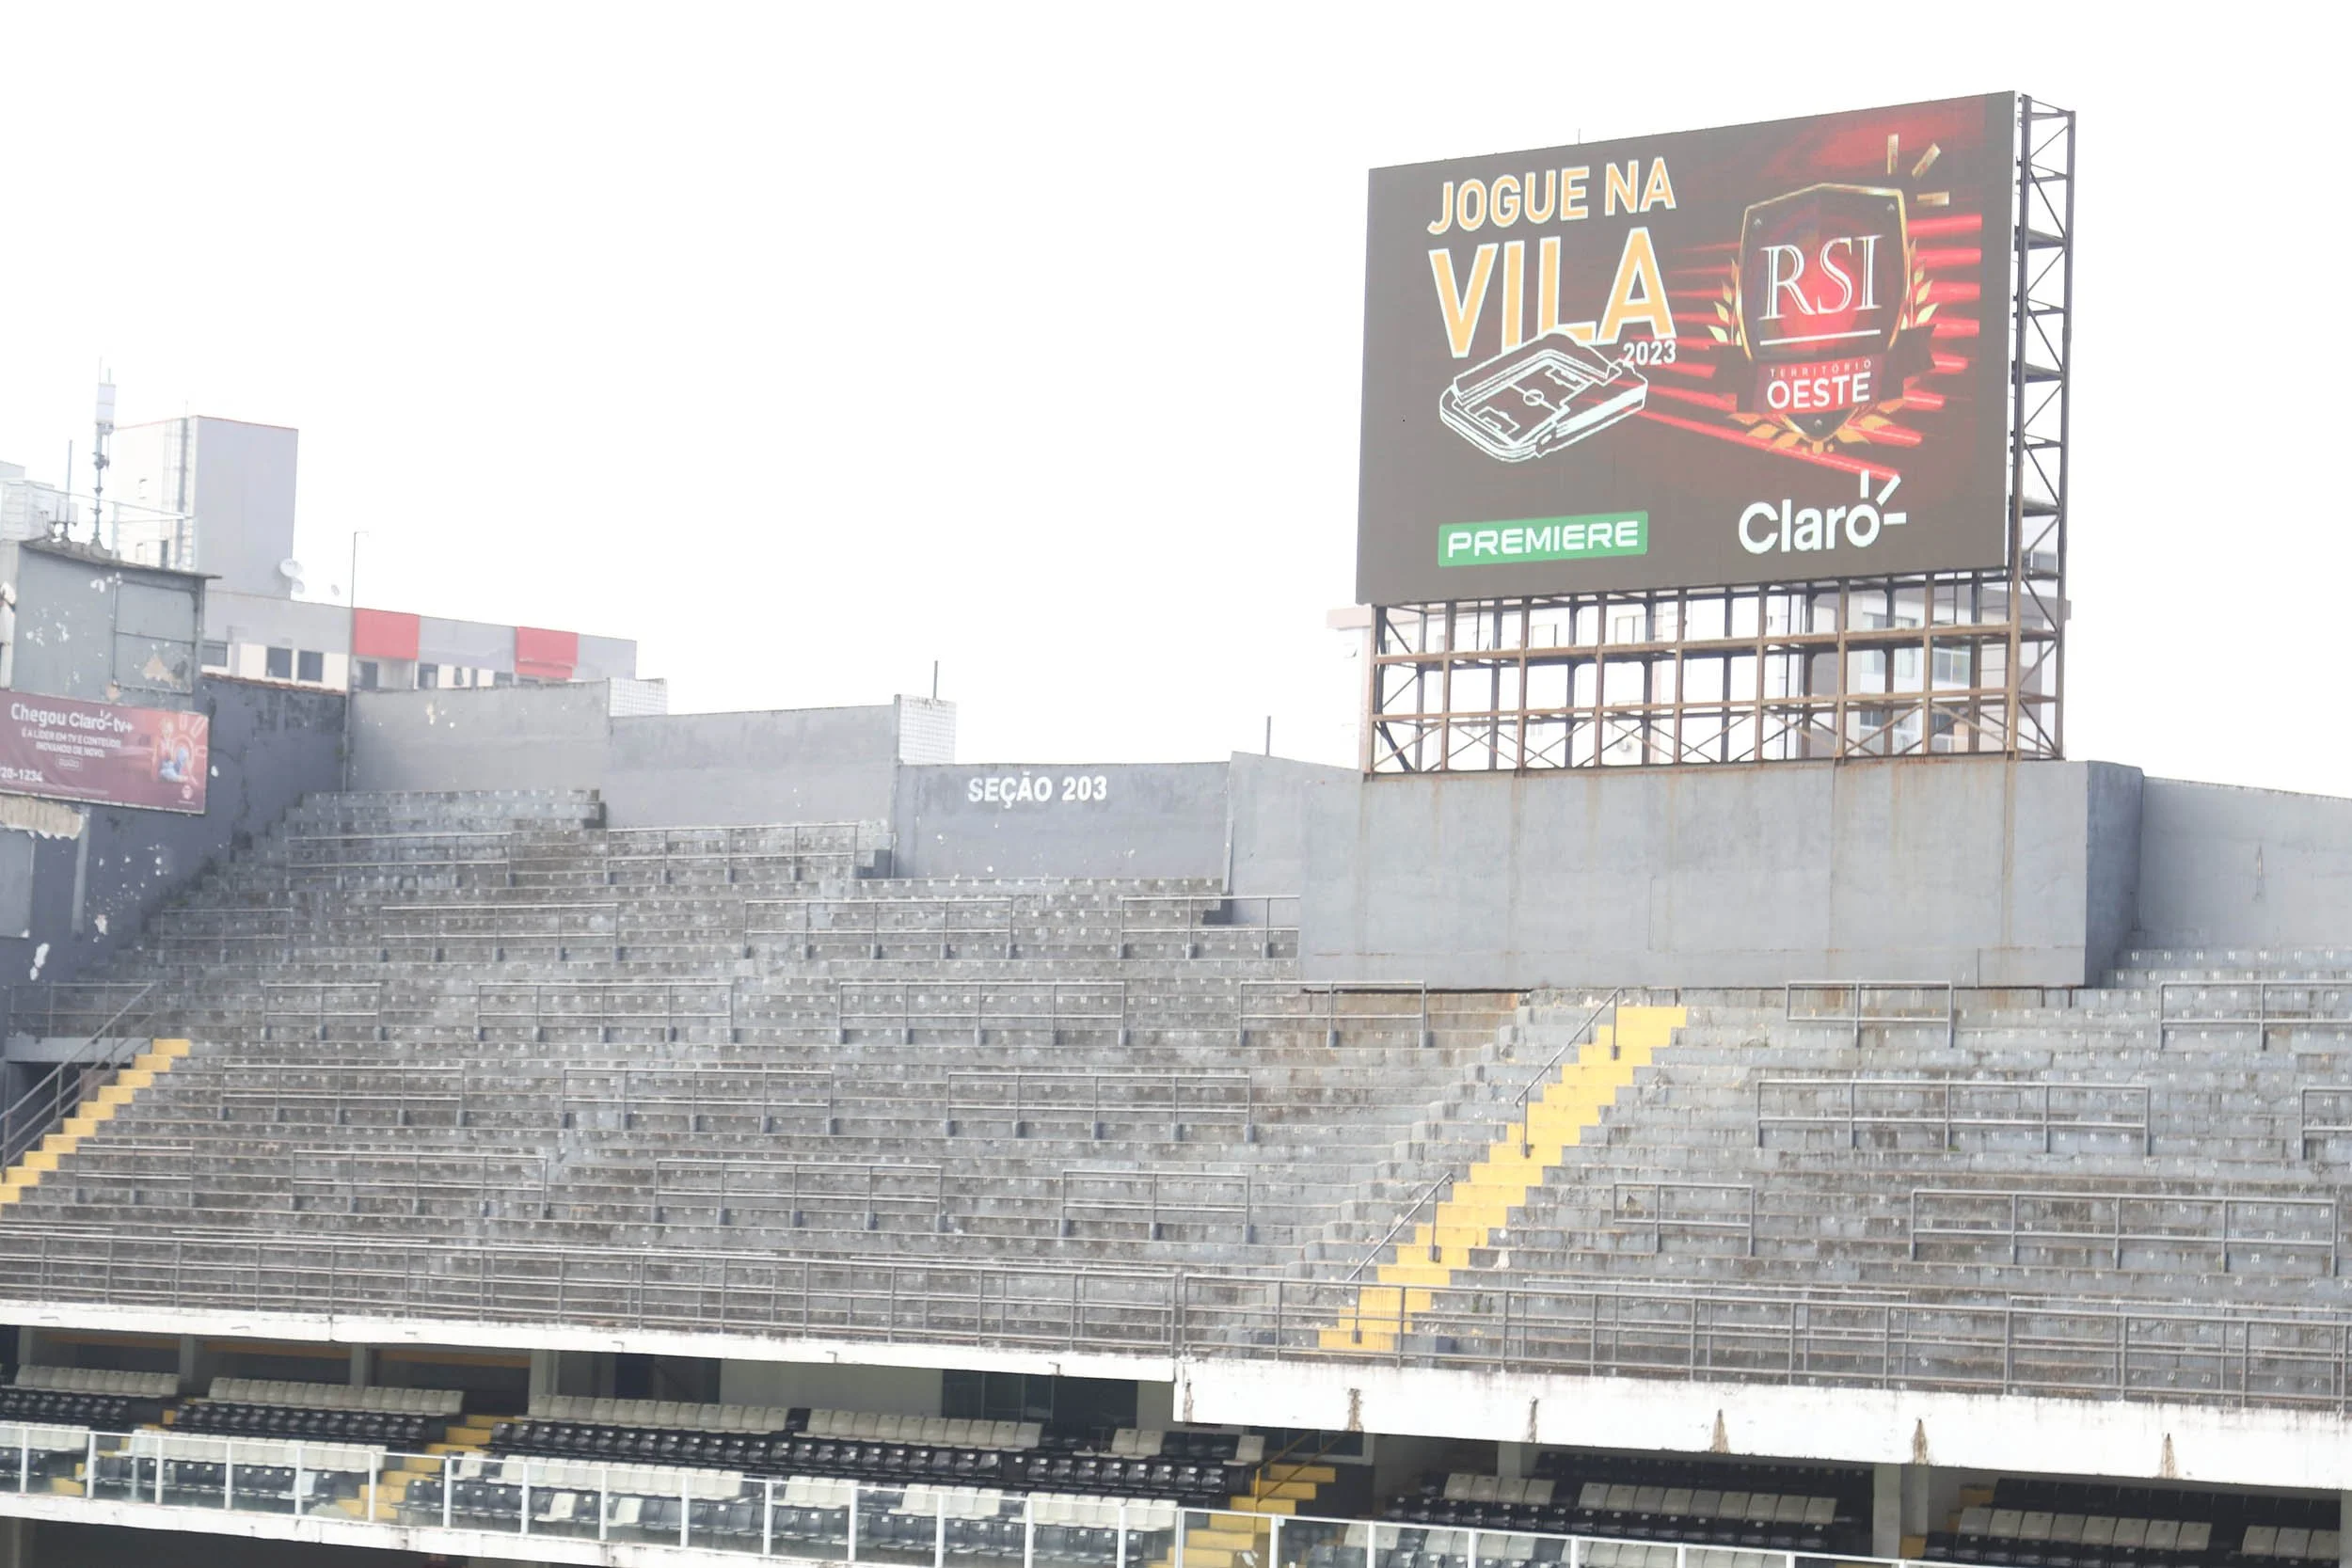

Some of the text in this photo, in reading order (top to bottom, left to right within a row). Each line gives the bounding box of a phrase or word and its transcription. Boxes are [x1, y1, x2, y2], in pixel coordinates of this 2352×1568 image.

[1427, 156, 1677, 235] JOGUE NA
[1428, 227, 1677, 358] VILA
[1757, 234, 1884, 320] RSI
[1623, 340, 1677, 366] 2023
[1767, 372, 1871, 409] OESTE
[1448, 520, 1638, 558] PREMIERE
[10, 703, 66, 728] Chegou
[967, 771, 1107, 809] SEÇÃO 203
